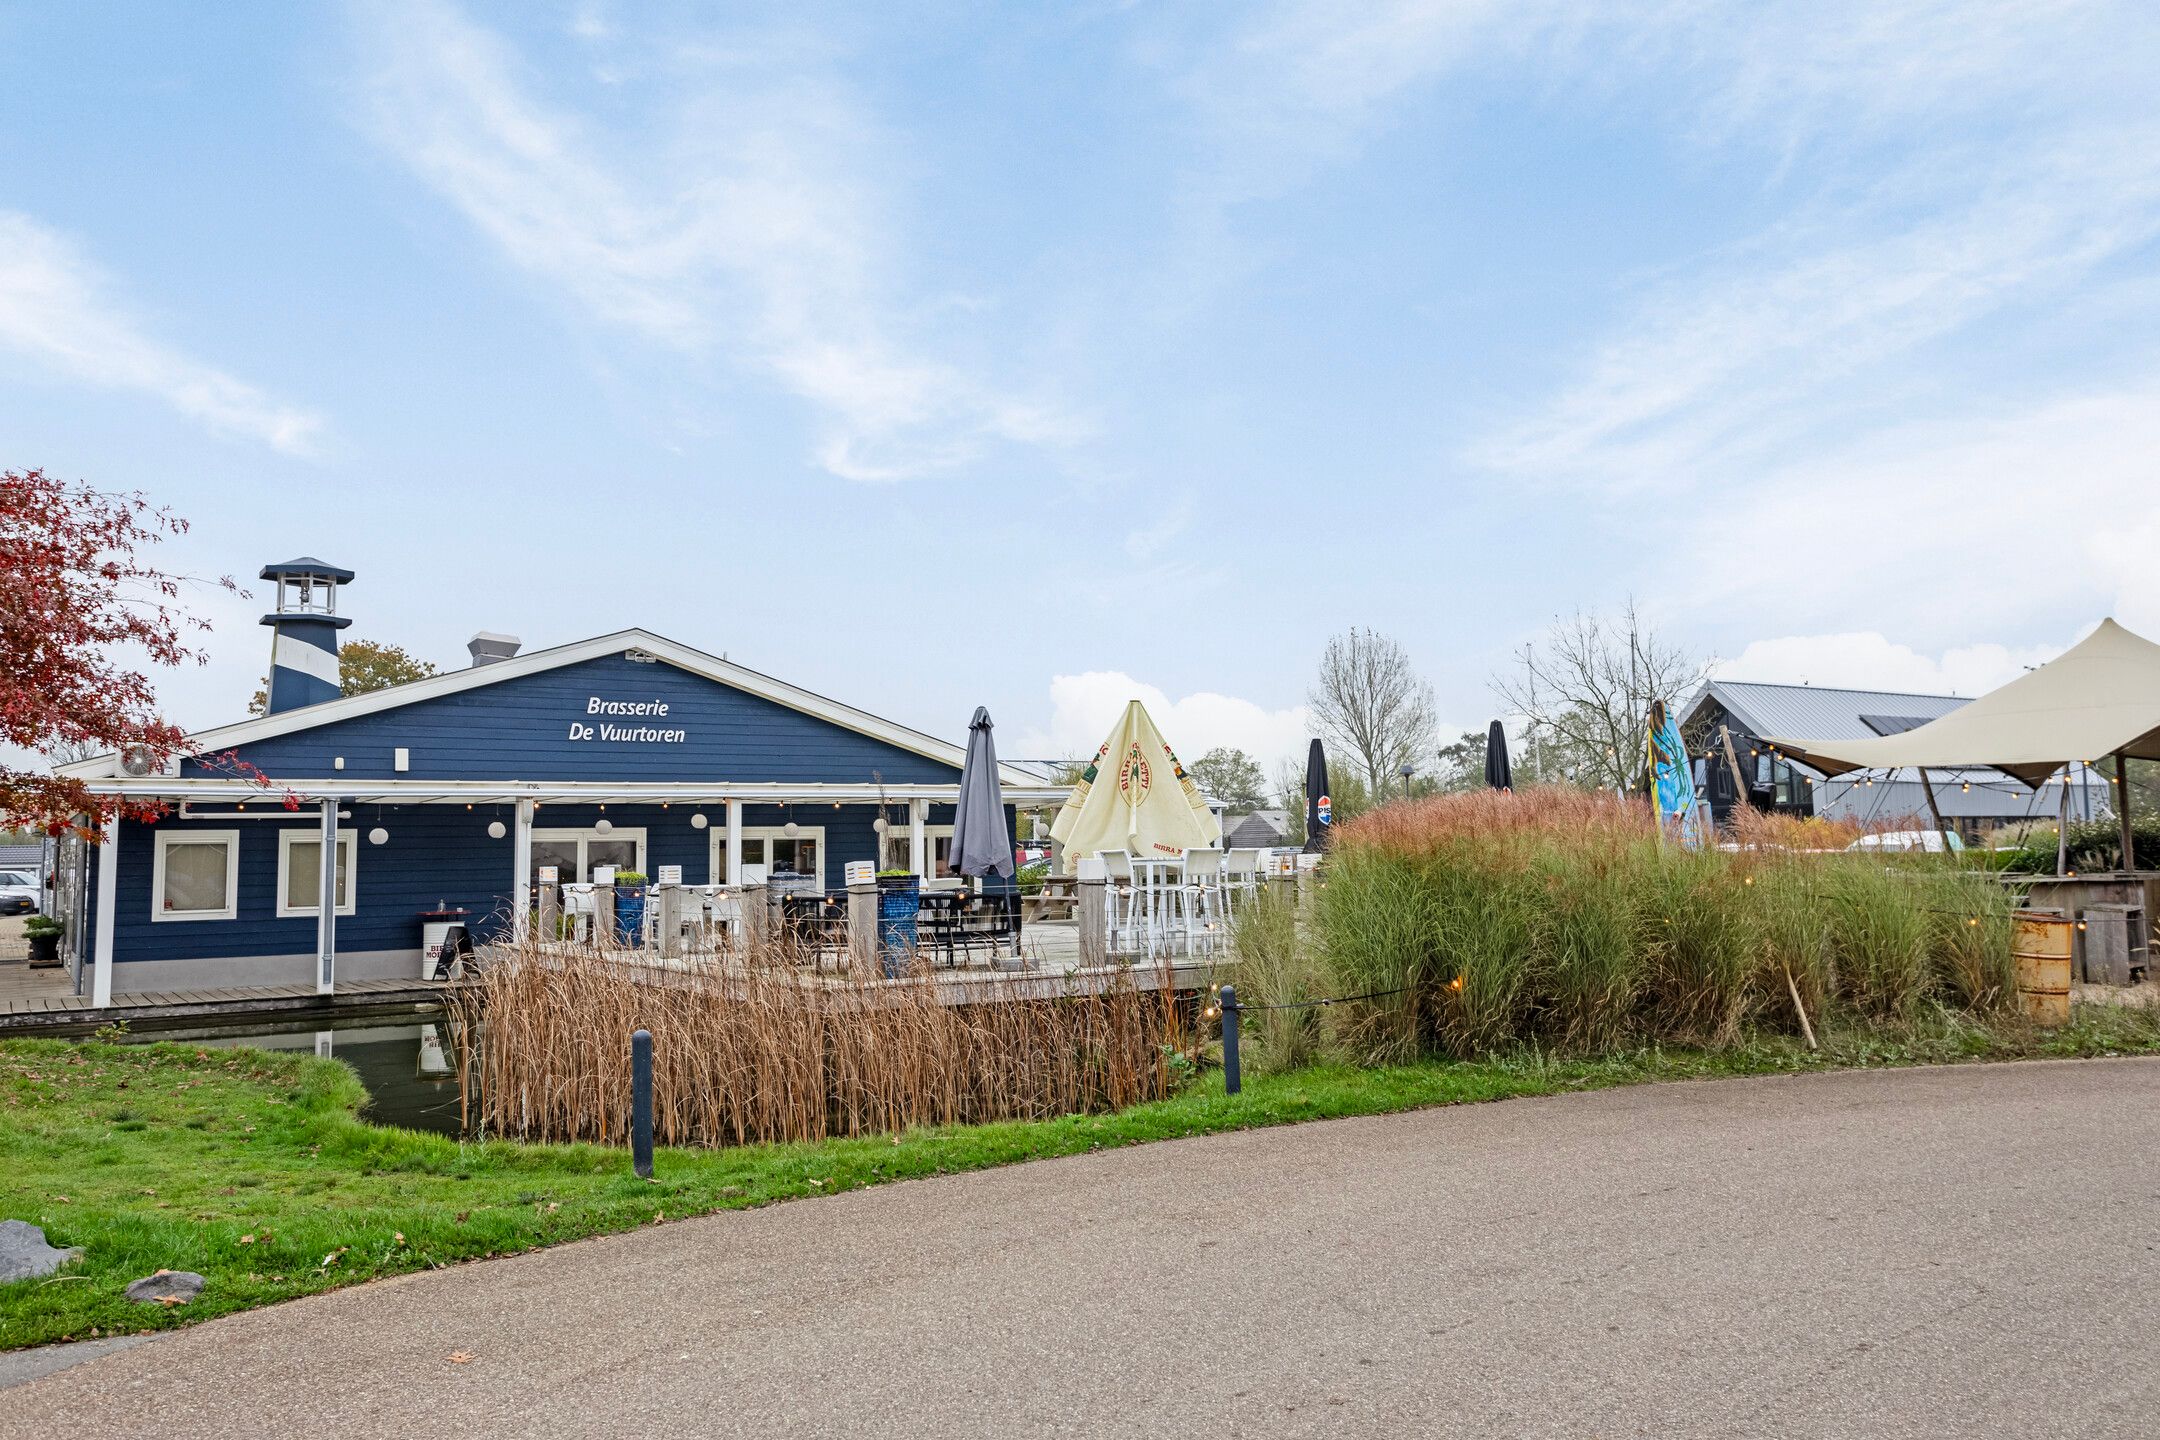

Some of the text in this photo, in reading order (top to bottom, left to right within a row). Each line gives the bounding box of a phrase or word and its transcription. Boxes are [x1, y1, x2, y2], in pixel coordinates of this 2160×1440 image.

[587, 697, 669, 717] Brasserie
[569, 723, 685, 743] De Vuurtoren
[1153, 842, 1175, 854] BIRRA
